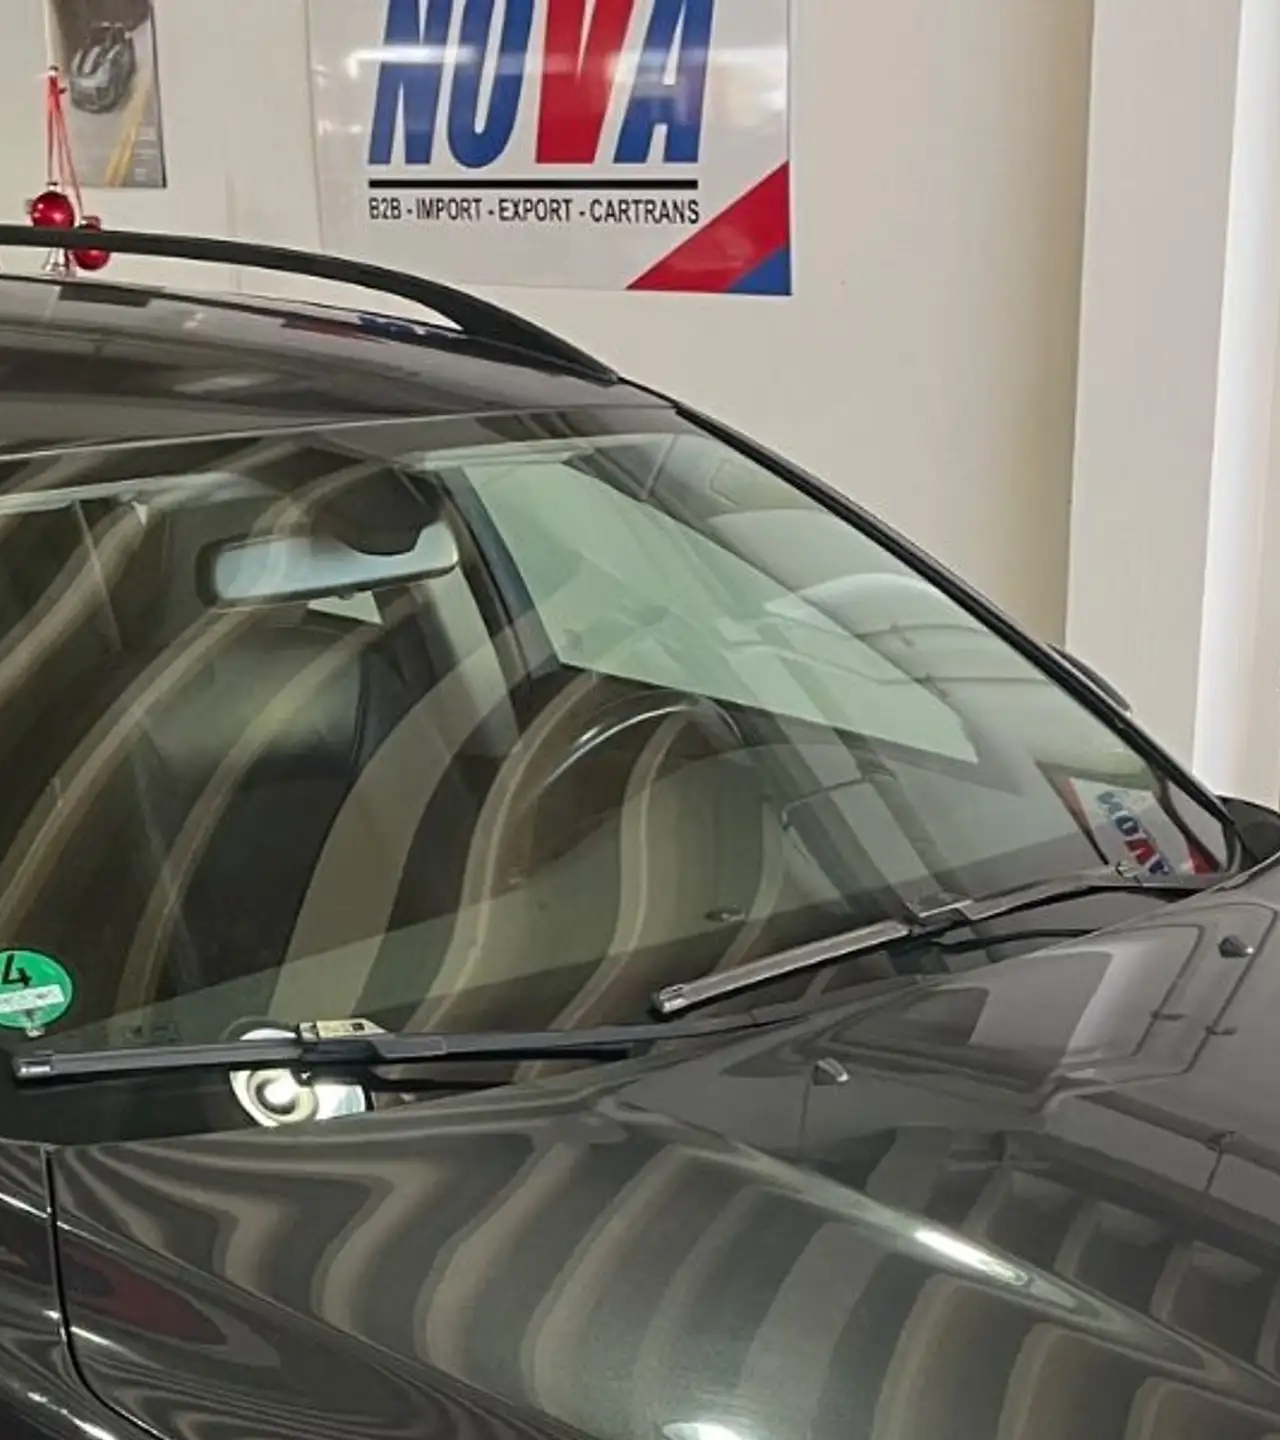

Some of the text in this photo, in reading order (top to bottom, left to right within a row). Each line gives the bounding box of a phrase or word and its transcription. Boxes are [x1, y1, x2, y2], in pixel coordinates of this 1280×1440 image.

[367, 0, 714, 168] NOVA
[368, 198, 402, 221] B2B
[416, 198, 483, 222] IMPORT
[498, 199, 572, 222] EXPORT
[589, 199, 700, 224] CARTRANS
[1, 953, 32, 986] 4
